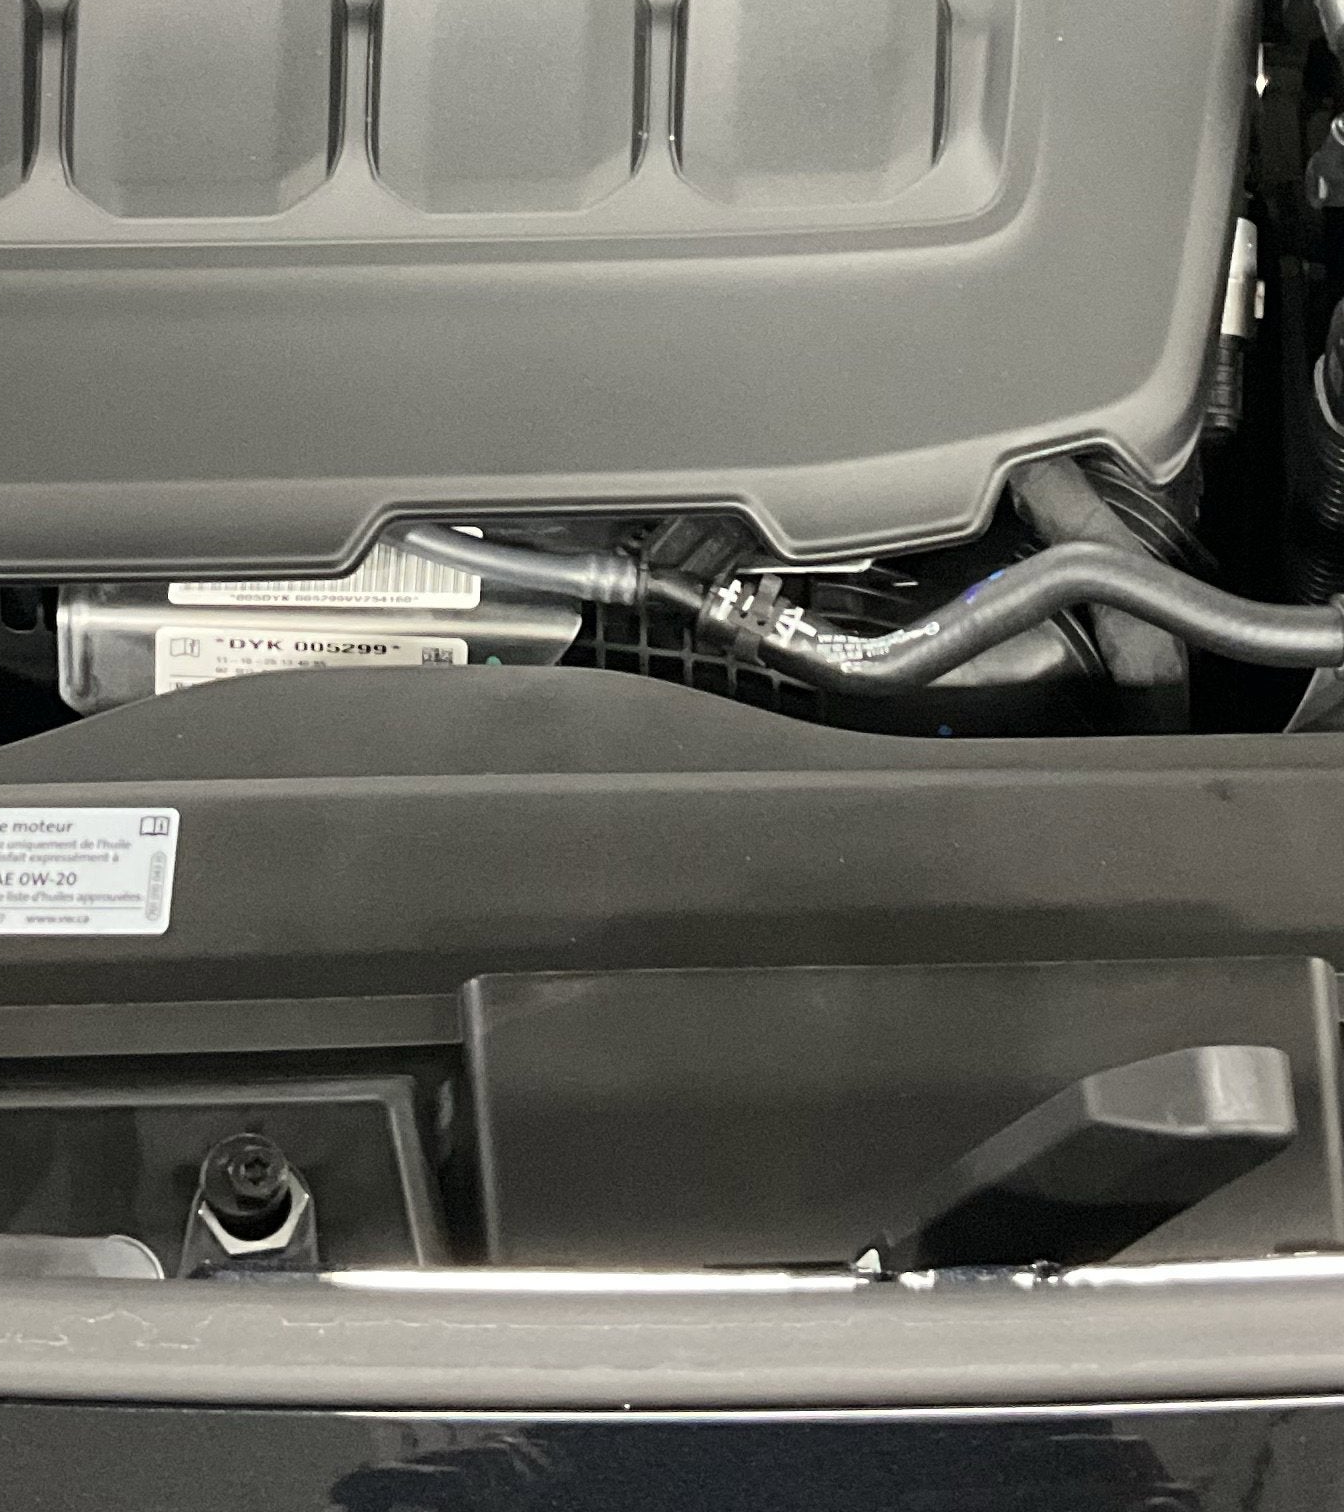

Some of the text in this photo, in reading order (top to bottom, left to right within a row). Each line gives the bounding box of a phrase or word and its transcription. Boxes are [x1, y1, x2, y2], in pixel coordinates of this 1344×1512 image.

[12, 820, 74, 834] moteur
[7, 840, 77, 853] uniquement
[80, 840, 95, 850] de
[19, 872, 77, 886] 0W-20
